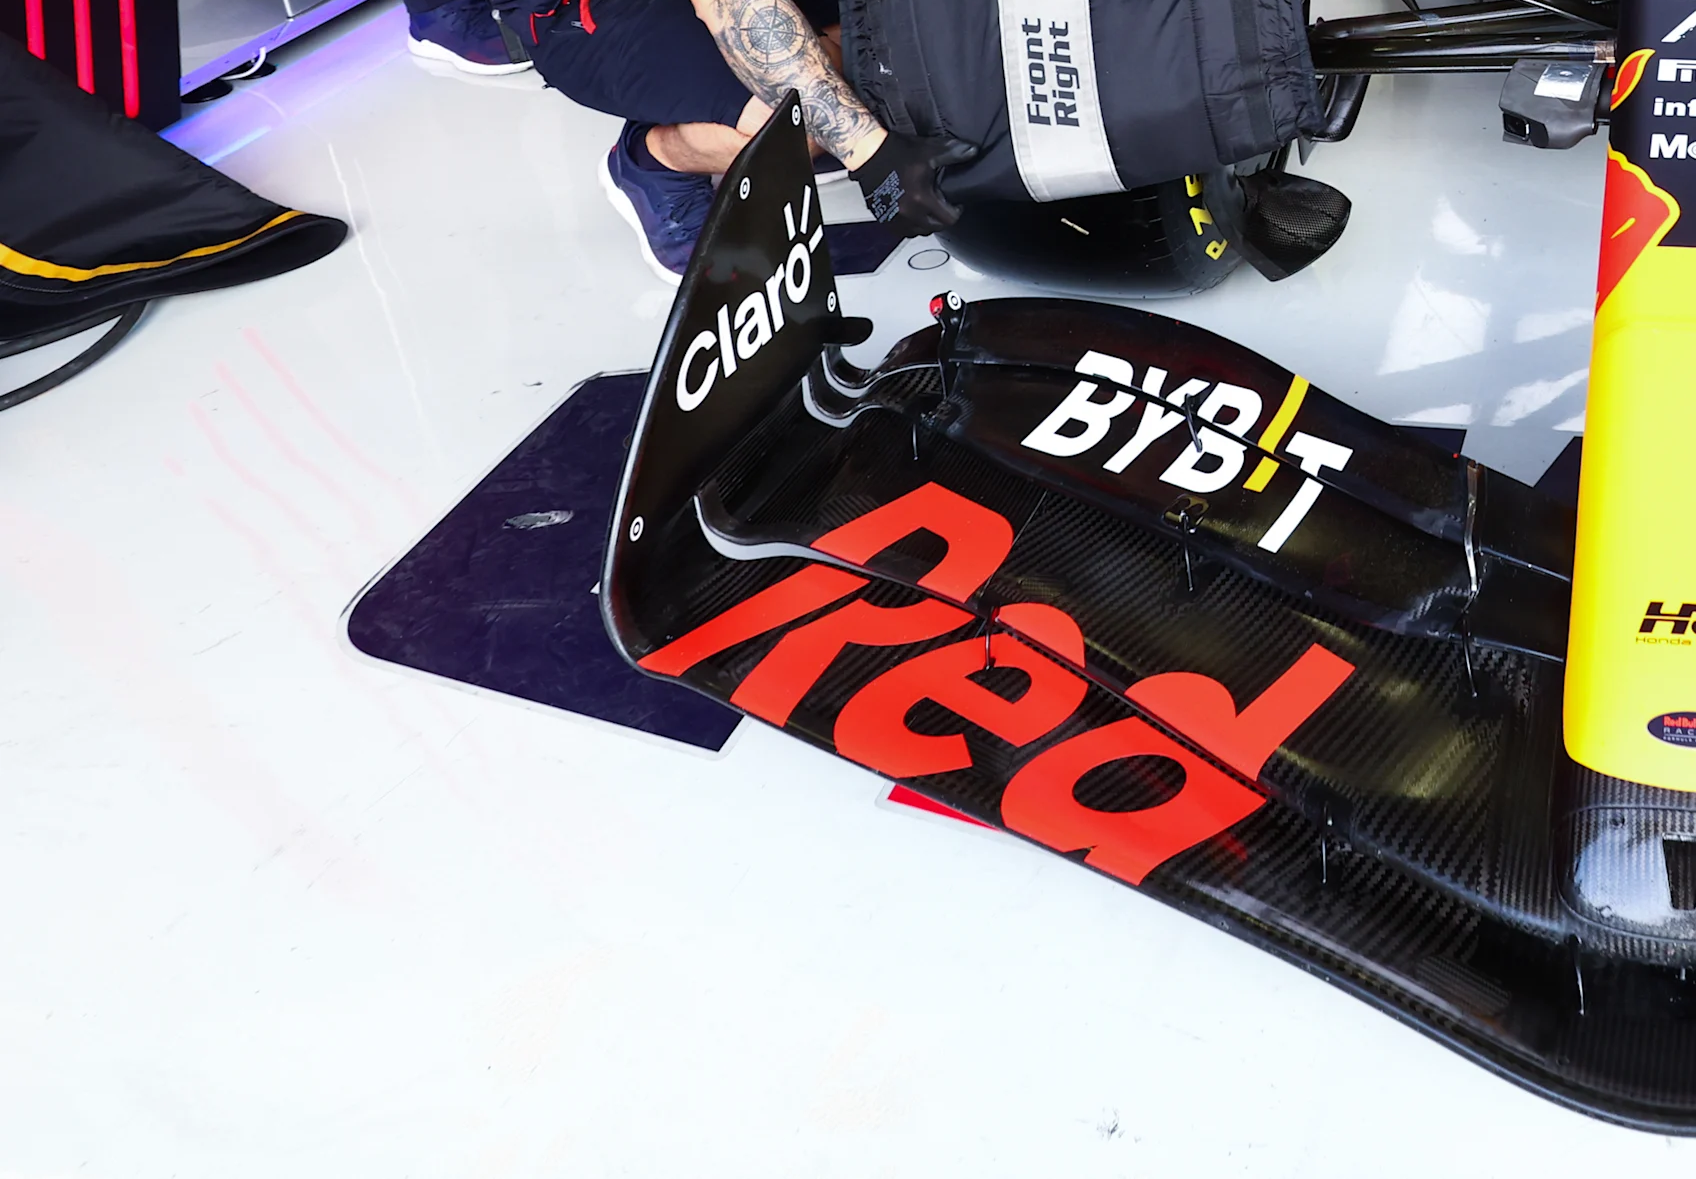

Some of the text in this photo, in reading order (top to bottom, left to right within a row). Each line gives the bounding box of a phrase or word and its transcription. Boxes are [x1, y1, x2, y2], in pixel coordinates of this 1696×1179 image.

[1021, 17, 1053, 128] Front
[1052, 20, 1083, 129] Right
[676, 217, 818, 412] Claro
[1021, 349, 1352, 553] BYBIT
[637, 481, 1355, 886] Red
[1635, 635, 1692, 647] Honda
[1663, 715, 1681, 728] Red
